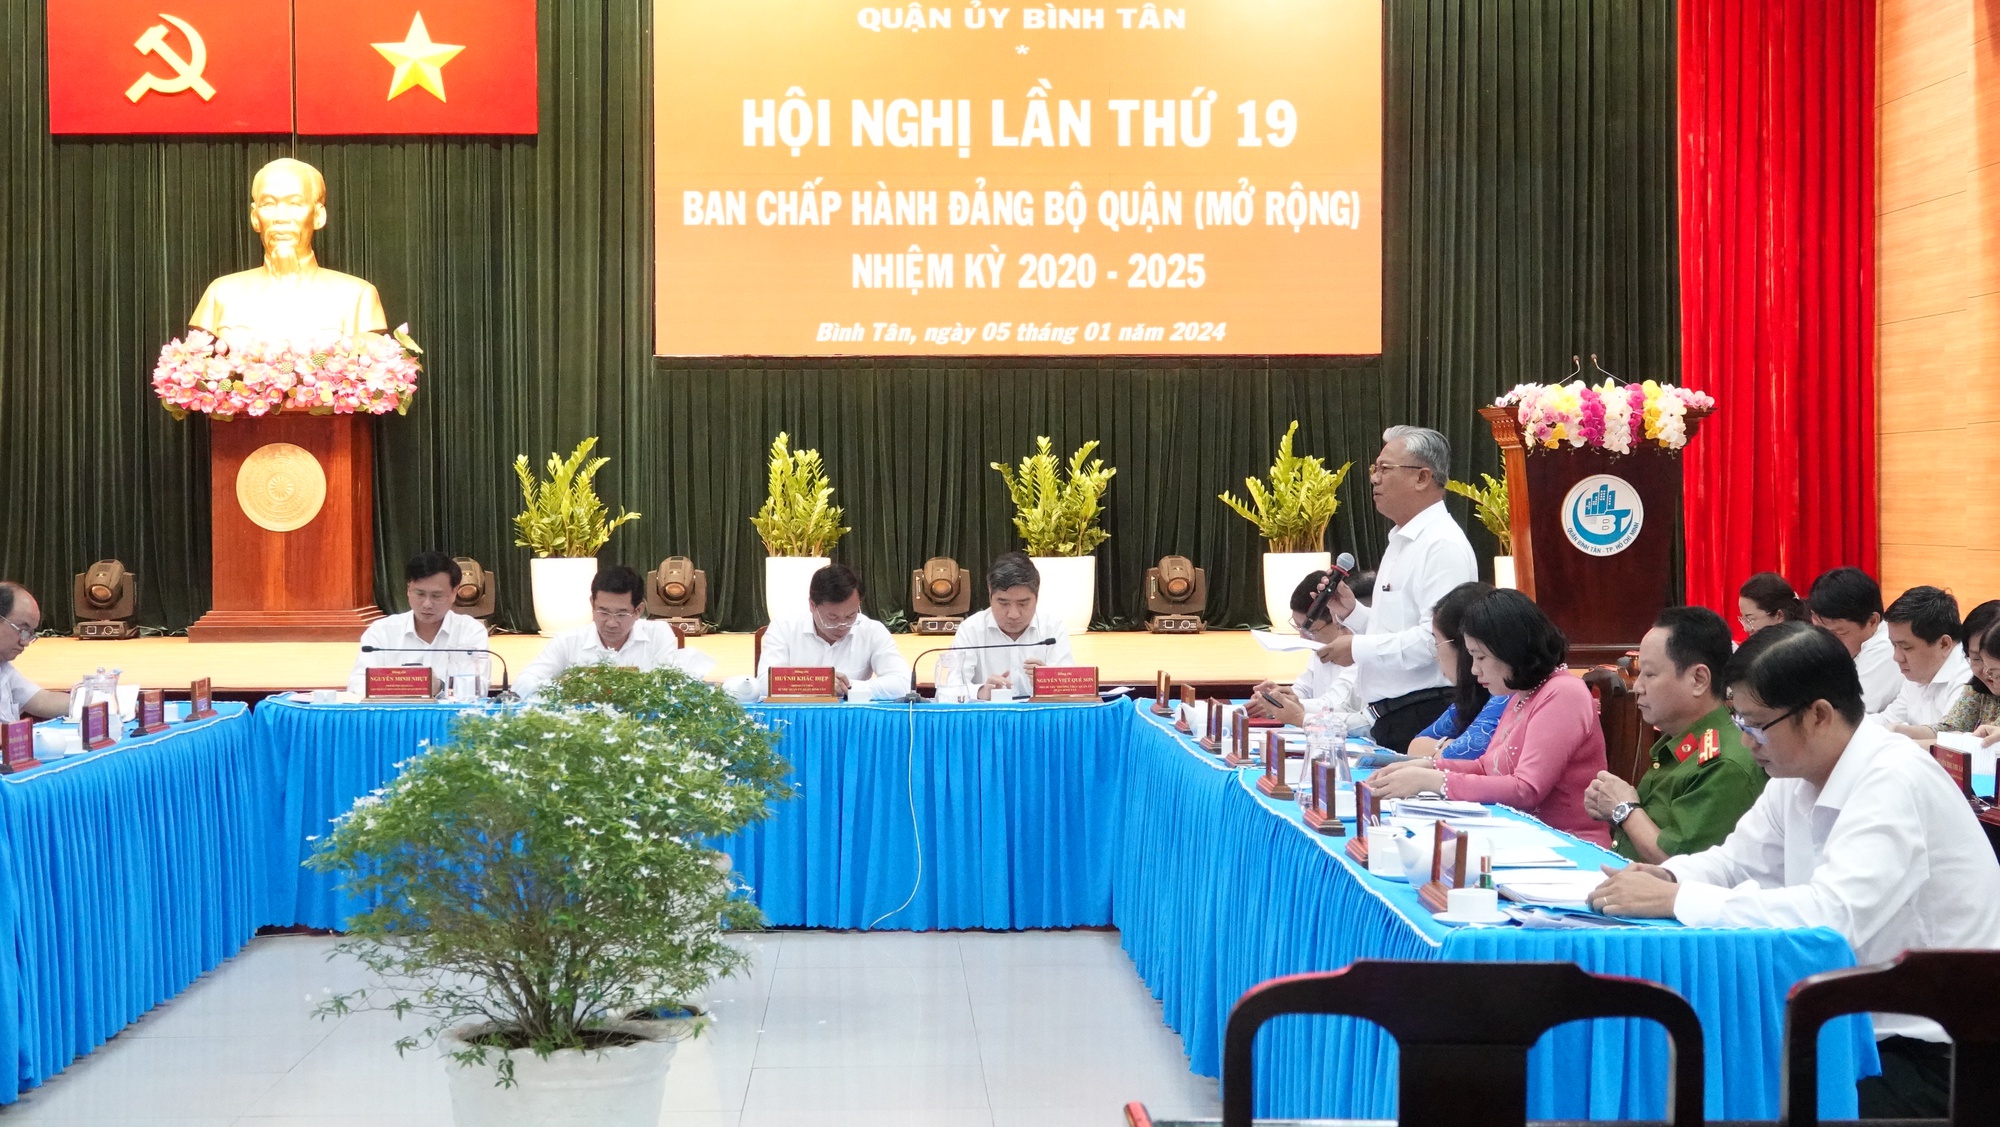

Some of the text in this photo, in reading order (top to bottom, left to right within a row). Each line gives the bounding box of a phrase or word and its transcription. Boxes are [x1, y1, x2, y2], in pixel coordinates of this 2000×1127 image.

[857, 0, 1186, 33] QUẬN ỦY BÌNH TÂN
[743, 78, 1297, 158] HỘI NGHỊ LẦN THỨ 19
[683, 177, 1360, 233] BAN CHẤP HÀNH ĐẢNG BỘ QUẬN (MỞ RỘNG)
[852, 244, 1206, 295] NHIỆM KỲ 2020 - 2025
[816, 322, 1226, 345] Bình Tân, ngày 05 tháng 01 năm 2024
[1577, 540, 1589, 550] BÌNH
[1630, 522, 1639, 536] MINH
